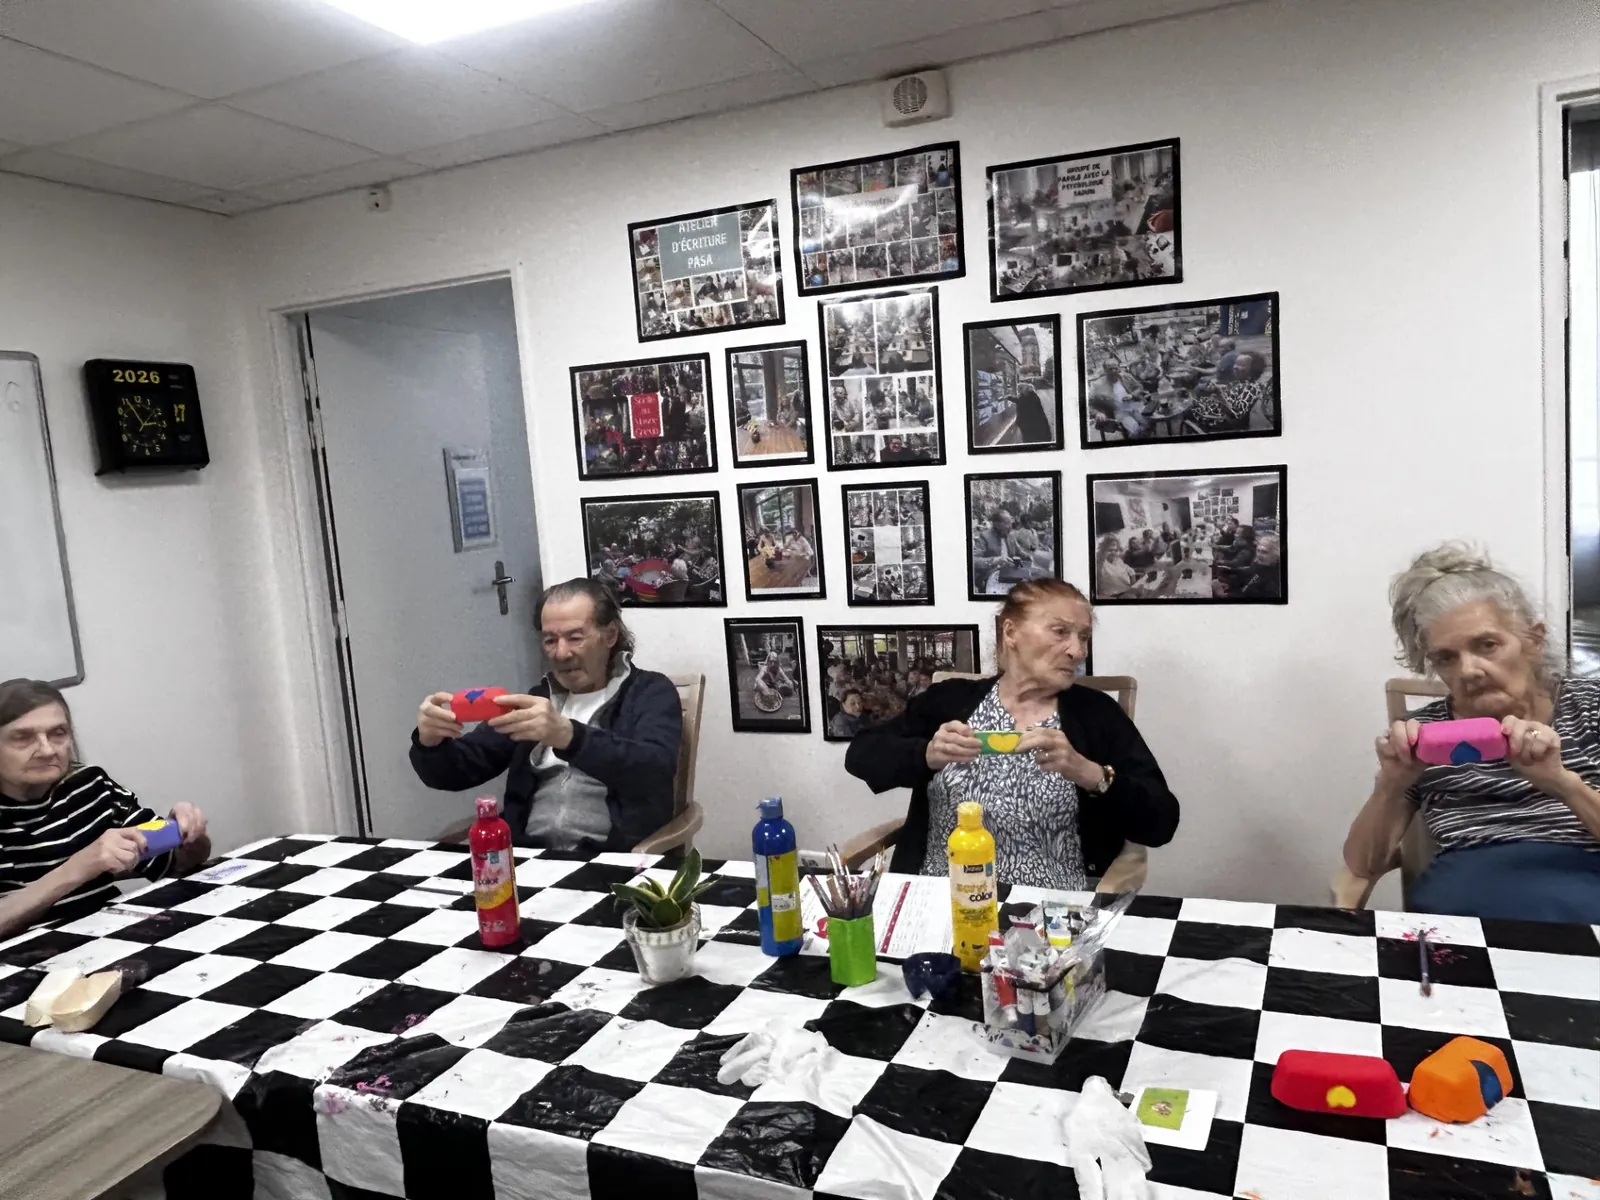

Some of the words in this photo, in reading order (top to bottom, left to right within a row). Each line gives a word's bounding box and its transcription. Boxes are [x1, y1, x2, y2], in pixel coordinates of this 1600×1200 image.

[1102, 169, 1110, 177] LA
[671, 233, 727, 253] D'ÉCRITURE
[687, 253, 714, 269] PASA
[112, 369, 161, 384] 2026
[969, 892, 993, 902] color
